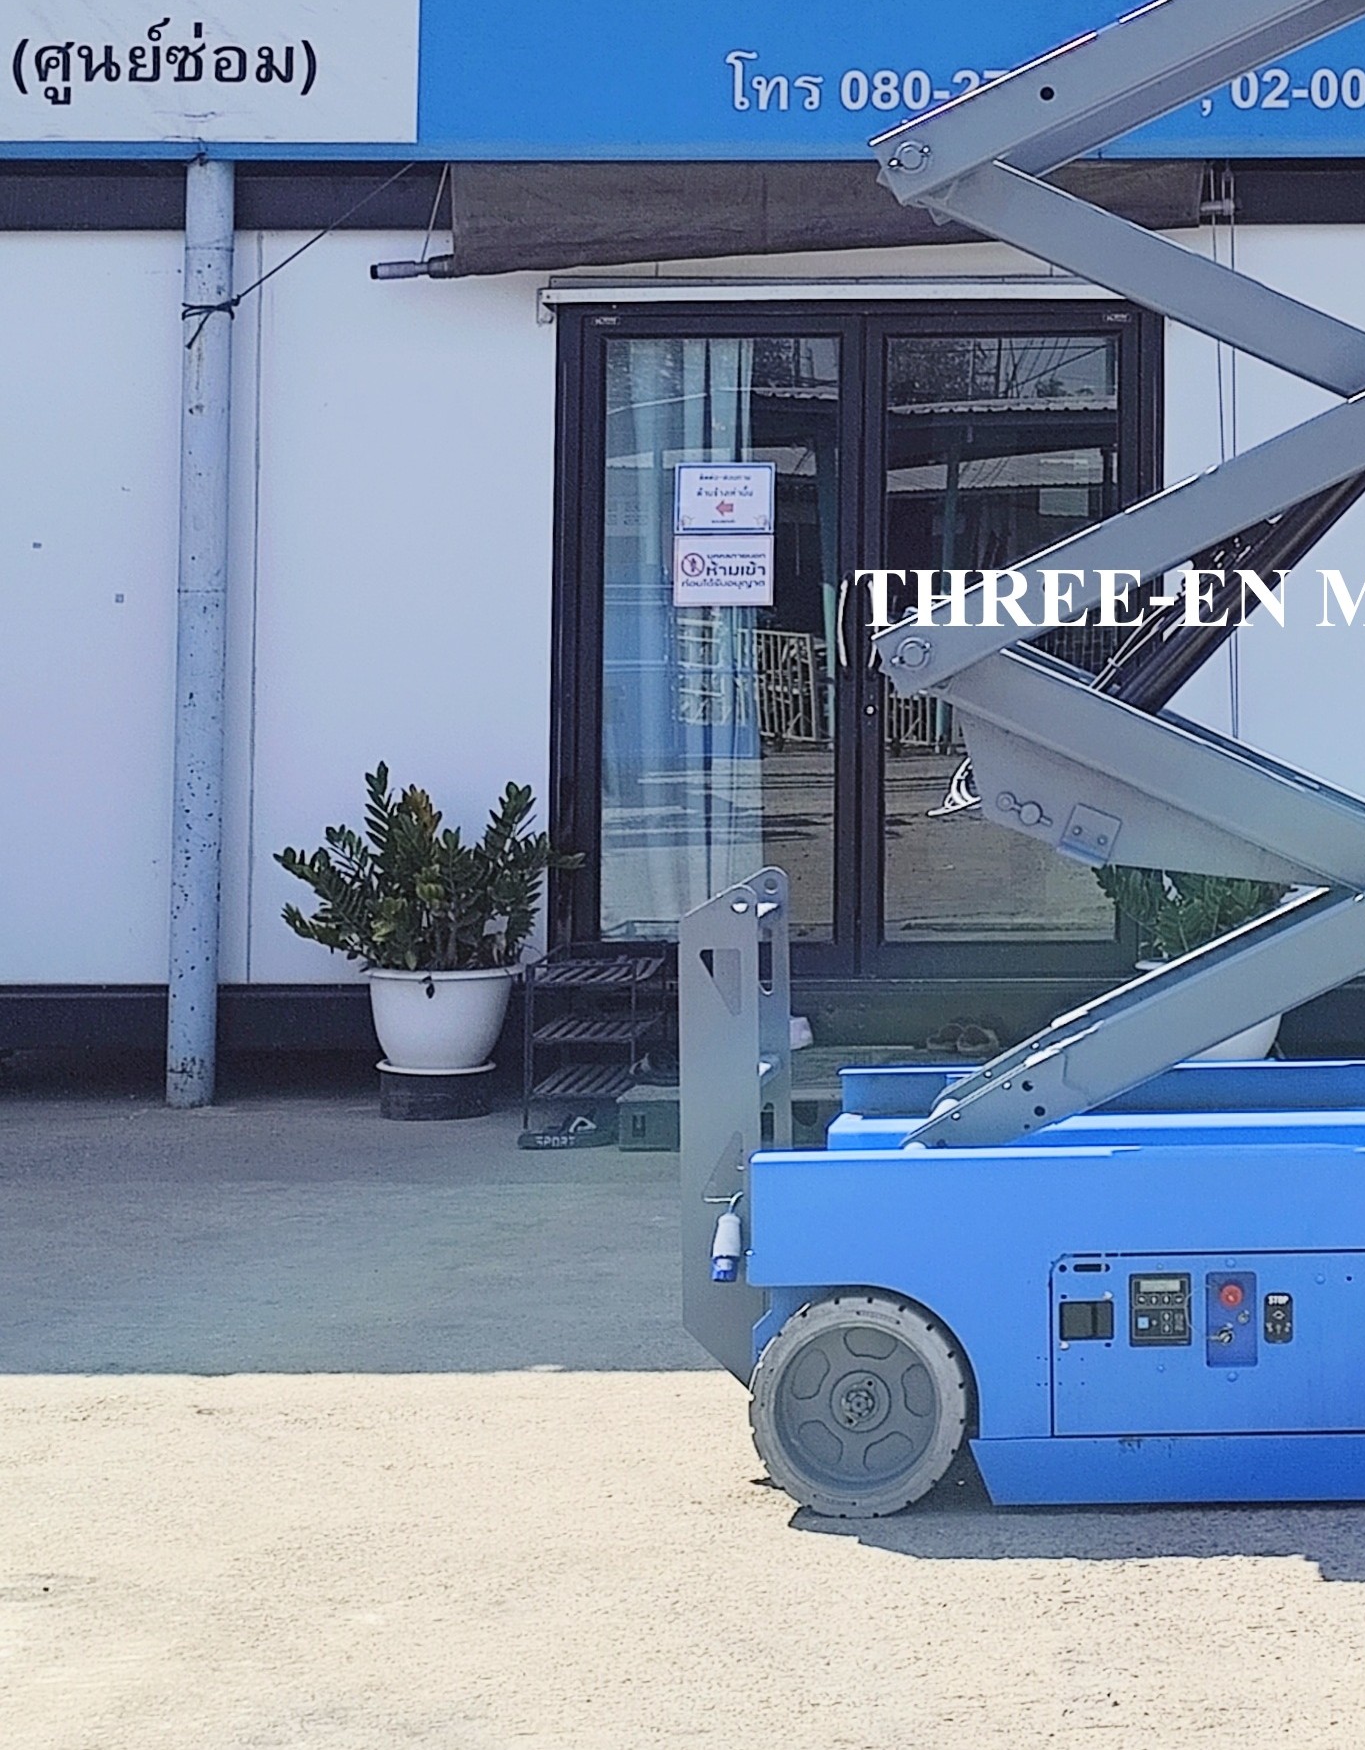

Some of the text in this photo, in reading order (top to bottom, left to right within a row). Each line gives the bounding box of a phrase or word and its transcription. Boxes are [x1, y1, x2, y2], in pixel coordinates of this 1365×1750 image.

[12, 17, 318, 106] (ศูนย์ซ่อม)
[725, 50, 824, 111] โทร
[706, 561, 766, 576] ห้ามเข้า
